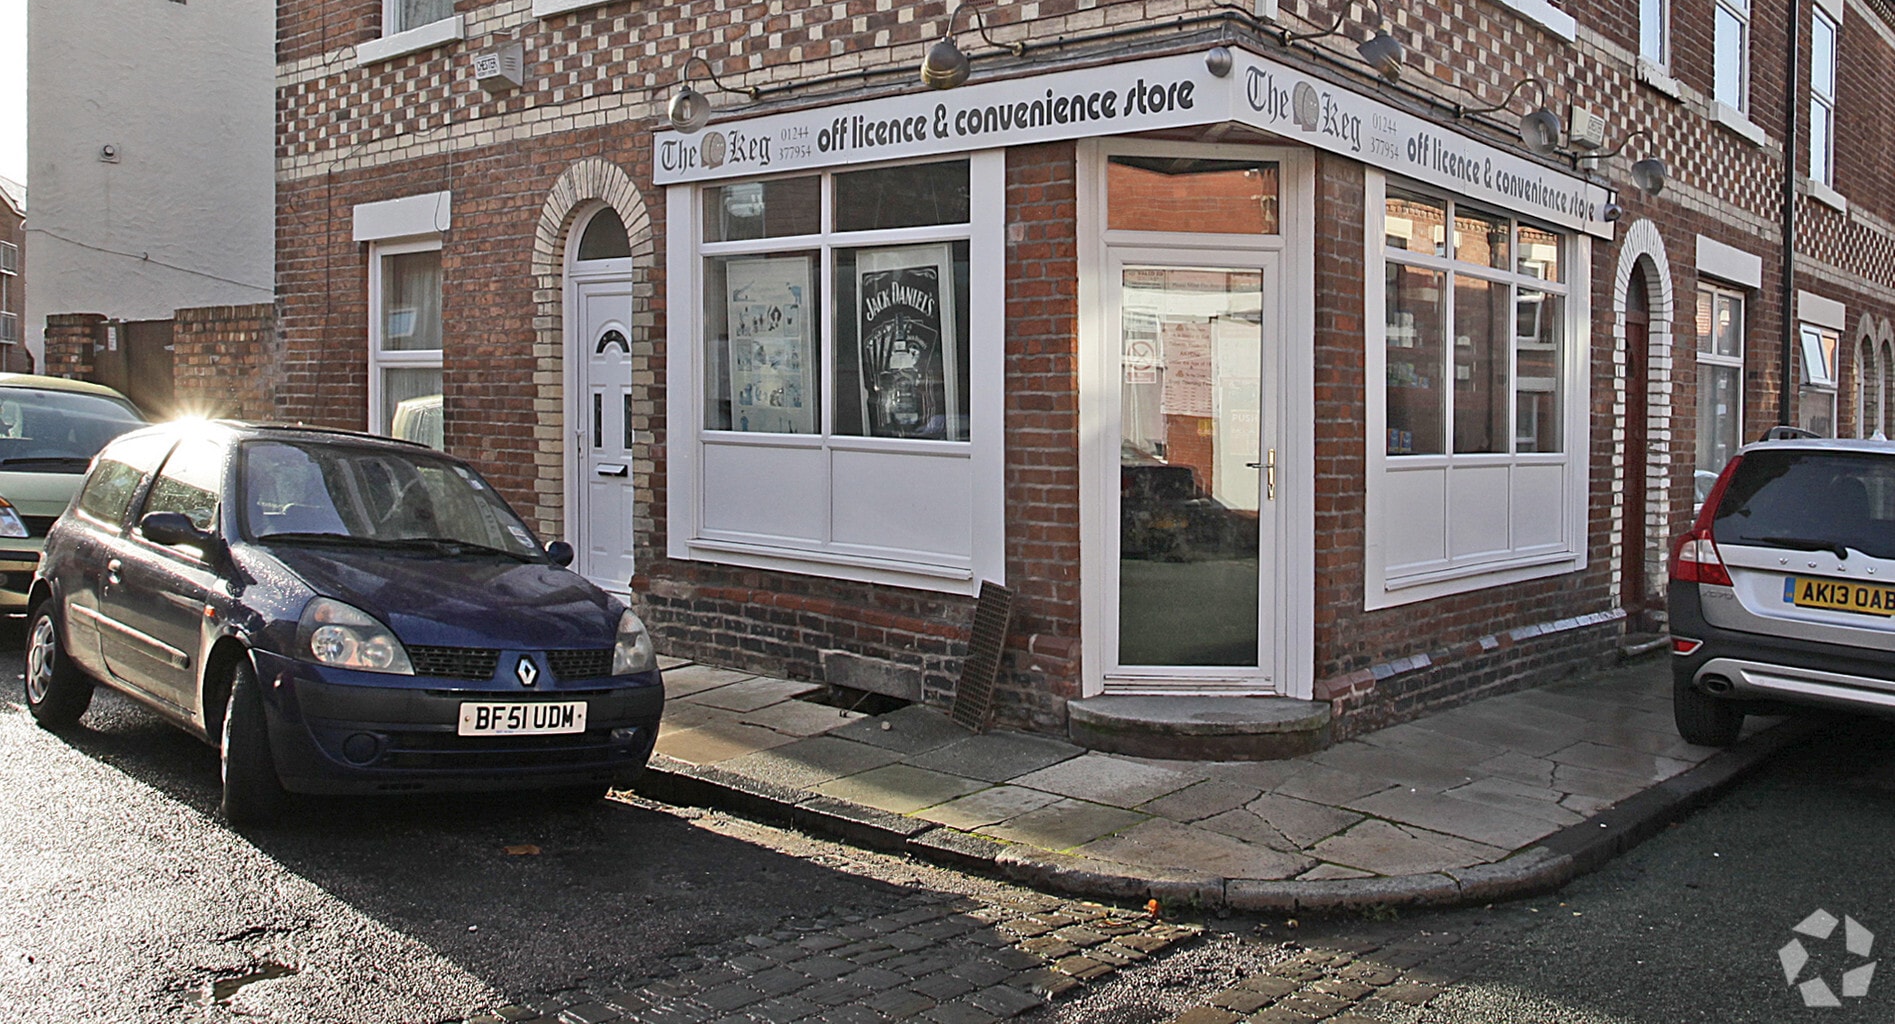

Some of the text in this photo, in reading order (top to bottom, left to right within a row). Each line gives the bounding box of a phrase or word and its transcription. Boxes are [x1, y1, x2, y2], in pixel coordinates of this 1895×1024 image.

[818, 79, 1195, 152] off licence & convenience store
[1246, 65, 1362, 152] The Keg
[780, 126, 809, 142] 01244
[1372, 112, 1397, 136] 01244
[660, 129, 772, 175] The Keg
[779, 145, 812, 161] 377954
[1370, 137, 1400, 161] 377954
[1407, 132, 1595, 222] off licence & convenience store
[866, 281, 935, 321] JACK DANIEL'S
[1802, 581, 1895, 610] AK13 OAB
[475, 704, 575, 730] BF51 UDM
